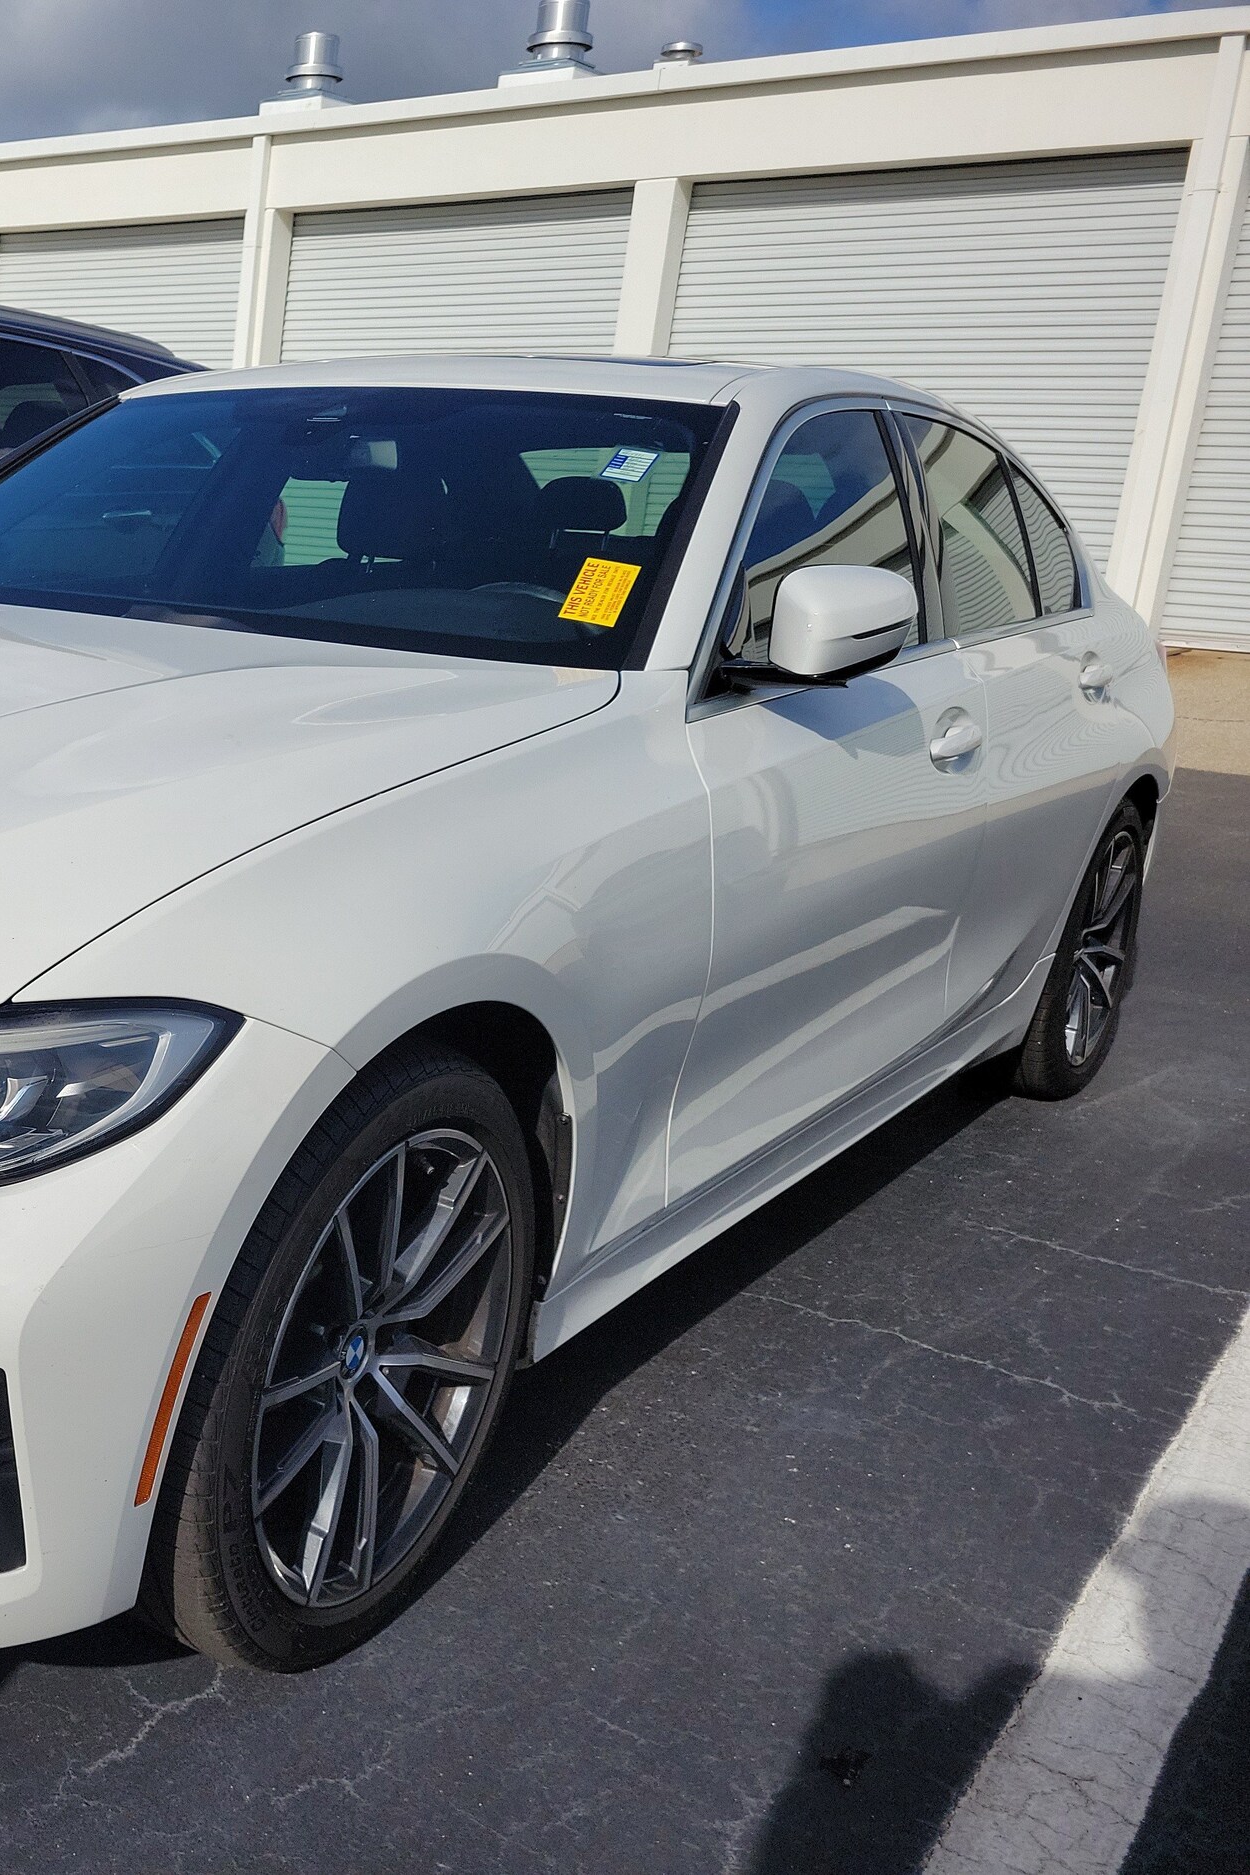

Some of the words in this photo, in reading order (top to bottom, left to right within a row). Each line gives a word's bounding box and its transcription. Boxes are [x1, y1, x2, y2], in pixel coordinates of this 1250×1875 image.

[573, 562, 600, 596] VEHICLE
[596, 564, 611, 578] SALE
[591, 578, 604, 589] FOR
[583, 588, 599, 606] READY
[564, 596, 583, 615] THIS
[577, 606, 591, 617] NOT
